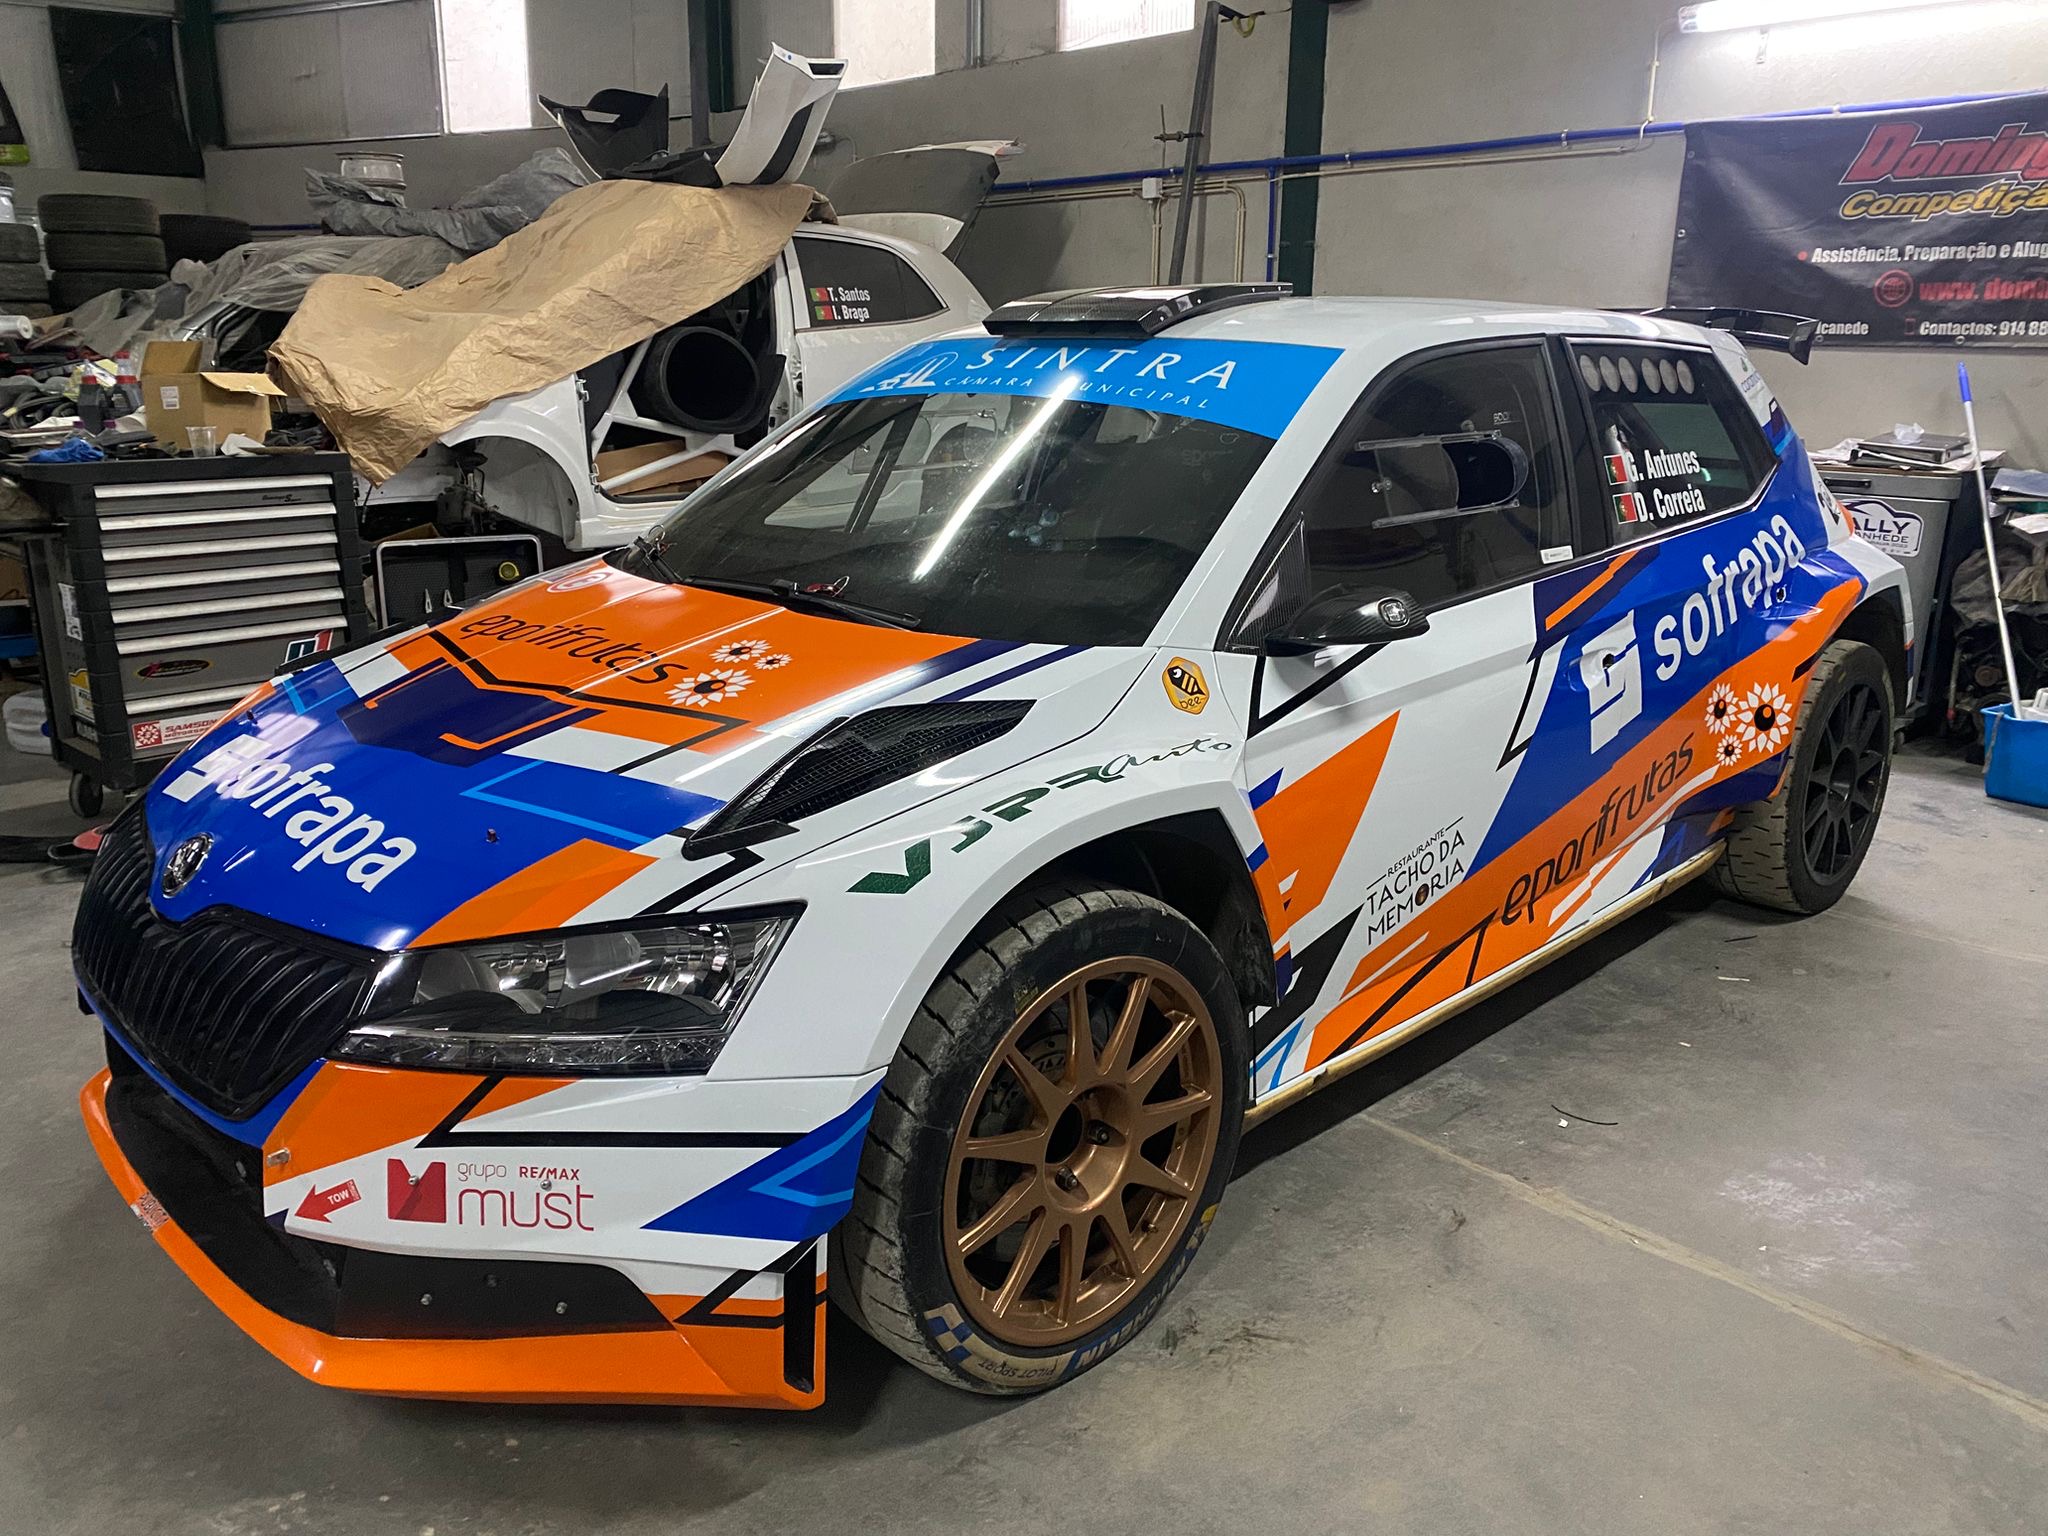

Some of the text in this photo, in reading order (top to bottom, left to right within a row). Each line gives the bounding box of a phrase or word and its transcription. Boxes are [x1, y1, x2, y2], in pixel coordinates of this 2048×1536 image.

[1811, 246, 1902, 263] Assistência,
[1904, 242, 1997, 263] Preparação
[1999, 244, 2011, 259] e
[827, 287, 871, 302] T. Santos
[842, 305, 870, 323] Braga
[1919, 320, 1997, 336] Contactos:
[1999, 321, 2026, 336] 914
[965, 346, 1247, 390] SINTRA
[1079, 381, 1210, 409] UNICIPAL
[1626, 448, 1701, 482] G. Antunes
[1634, 483, 1707, 523] D. Correia
[1851, 517, 1912, 535] ALLY
[1653, 513, 1806, 682] sofrapa
[1179, 696, 1202, 709] bee
[216, 758, 418, 894] sofrapa
[1387, 827, 1445, 878] RESTAURANTE
[1366, 829, 1465, 916] TACHO DA
[1367, 858, 1465, 946] MEMORIA
[457, 1162, 580, 1182] grupo RE/MAX
[327, 1188, 349, 1206] TOW
[458, 1184, 595, 1232] must
[978, 1358, 1057, 1379] PILOT SPORT
